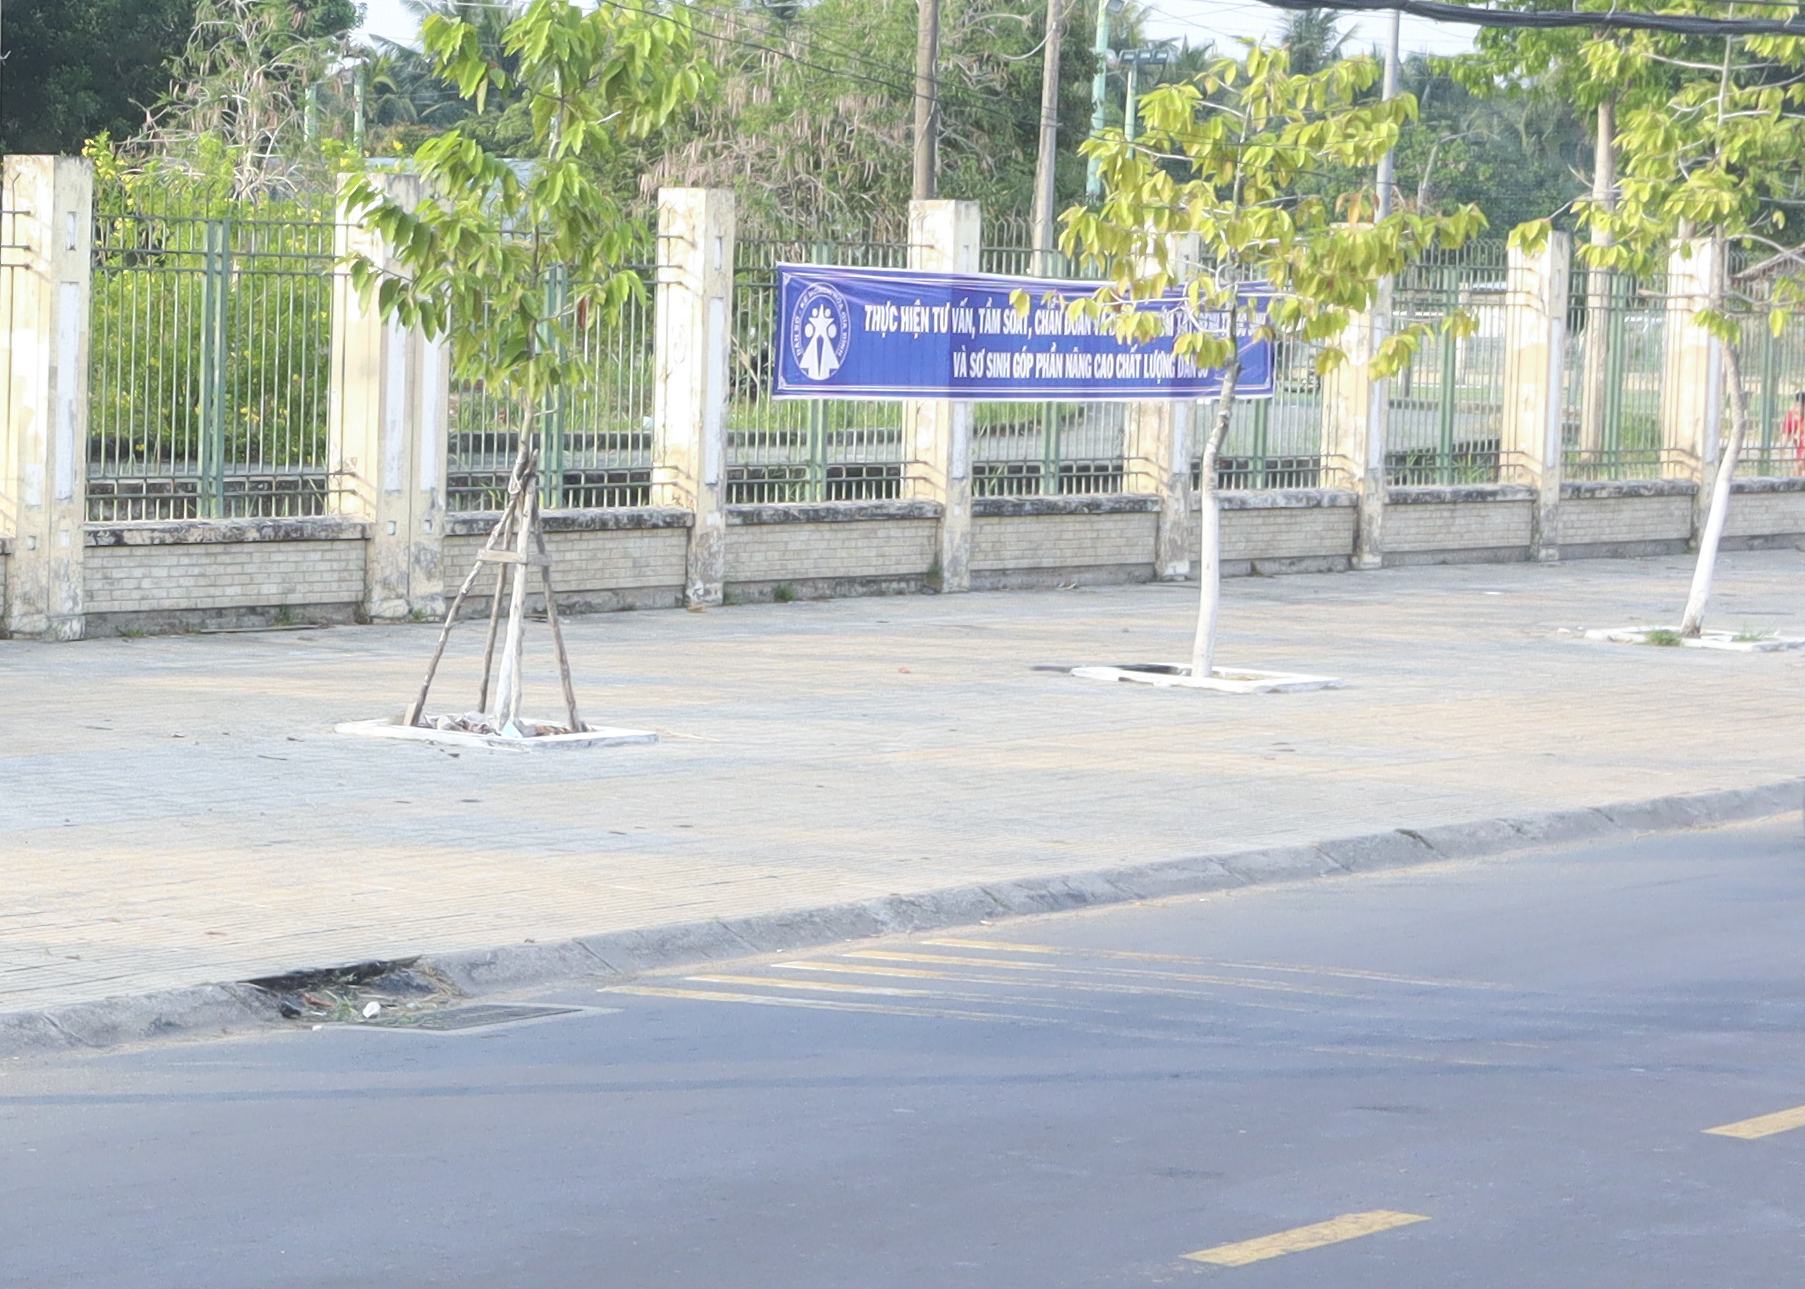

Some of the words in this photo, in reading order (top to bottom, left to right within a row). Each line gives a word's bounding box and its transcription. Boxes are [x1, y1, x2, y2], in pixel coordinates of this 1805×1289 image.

[865, 300, 898, 338] THỰC
[900, 299, 930, 339] HIỆN
[932, 302, 950, 333] TƯ
[952, 297, 976, 339] VẤN,
[953, 345, 968, 378] VÀ
[969, 348, 986, 379] SƠ
[986, 352, 1011, 379] SINH
[1013, 345, 1034, 379] GÓP
[1065, 347, 1092, 379] NÂNG
[1094, 353, 1114, 379] CAO
[1116, 344, 1142, 379] CHẤT
[1143, 349, 1176, 384] LƯỢNG
